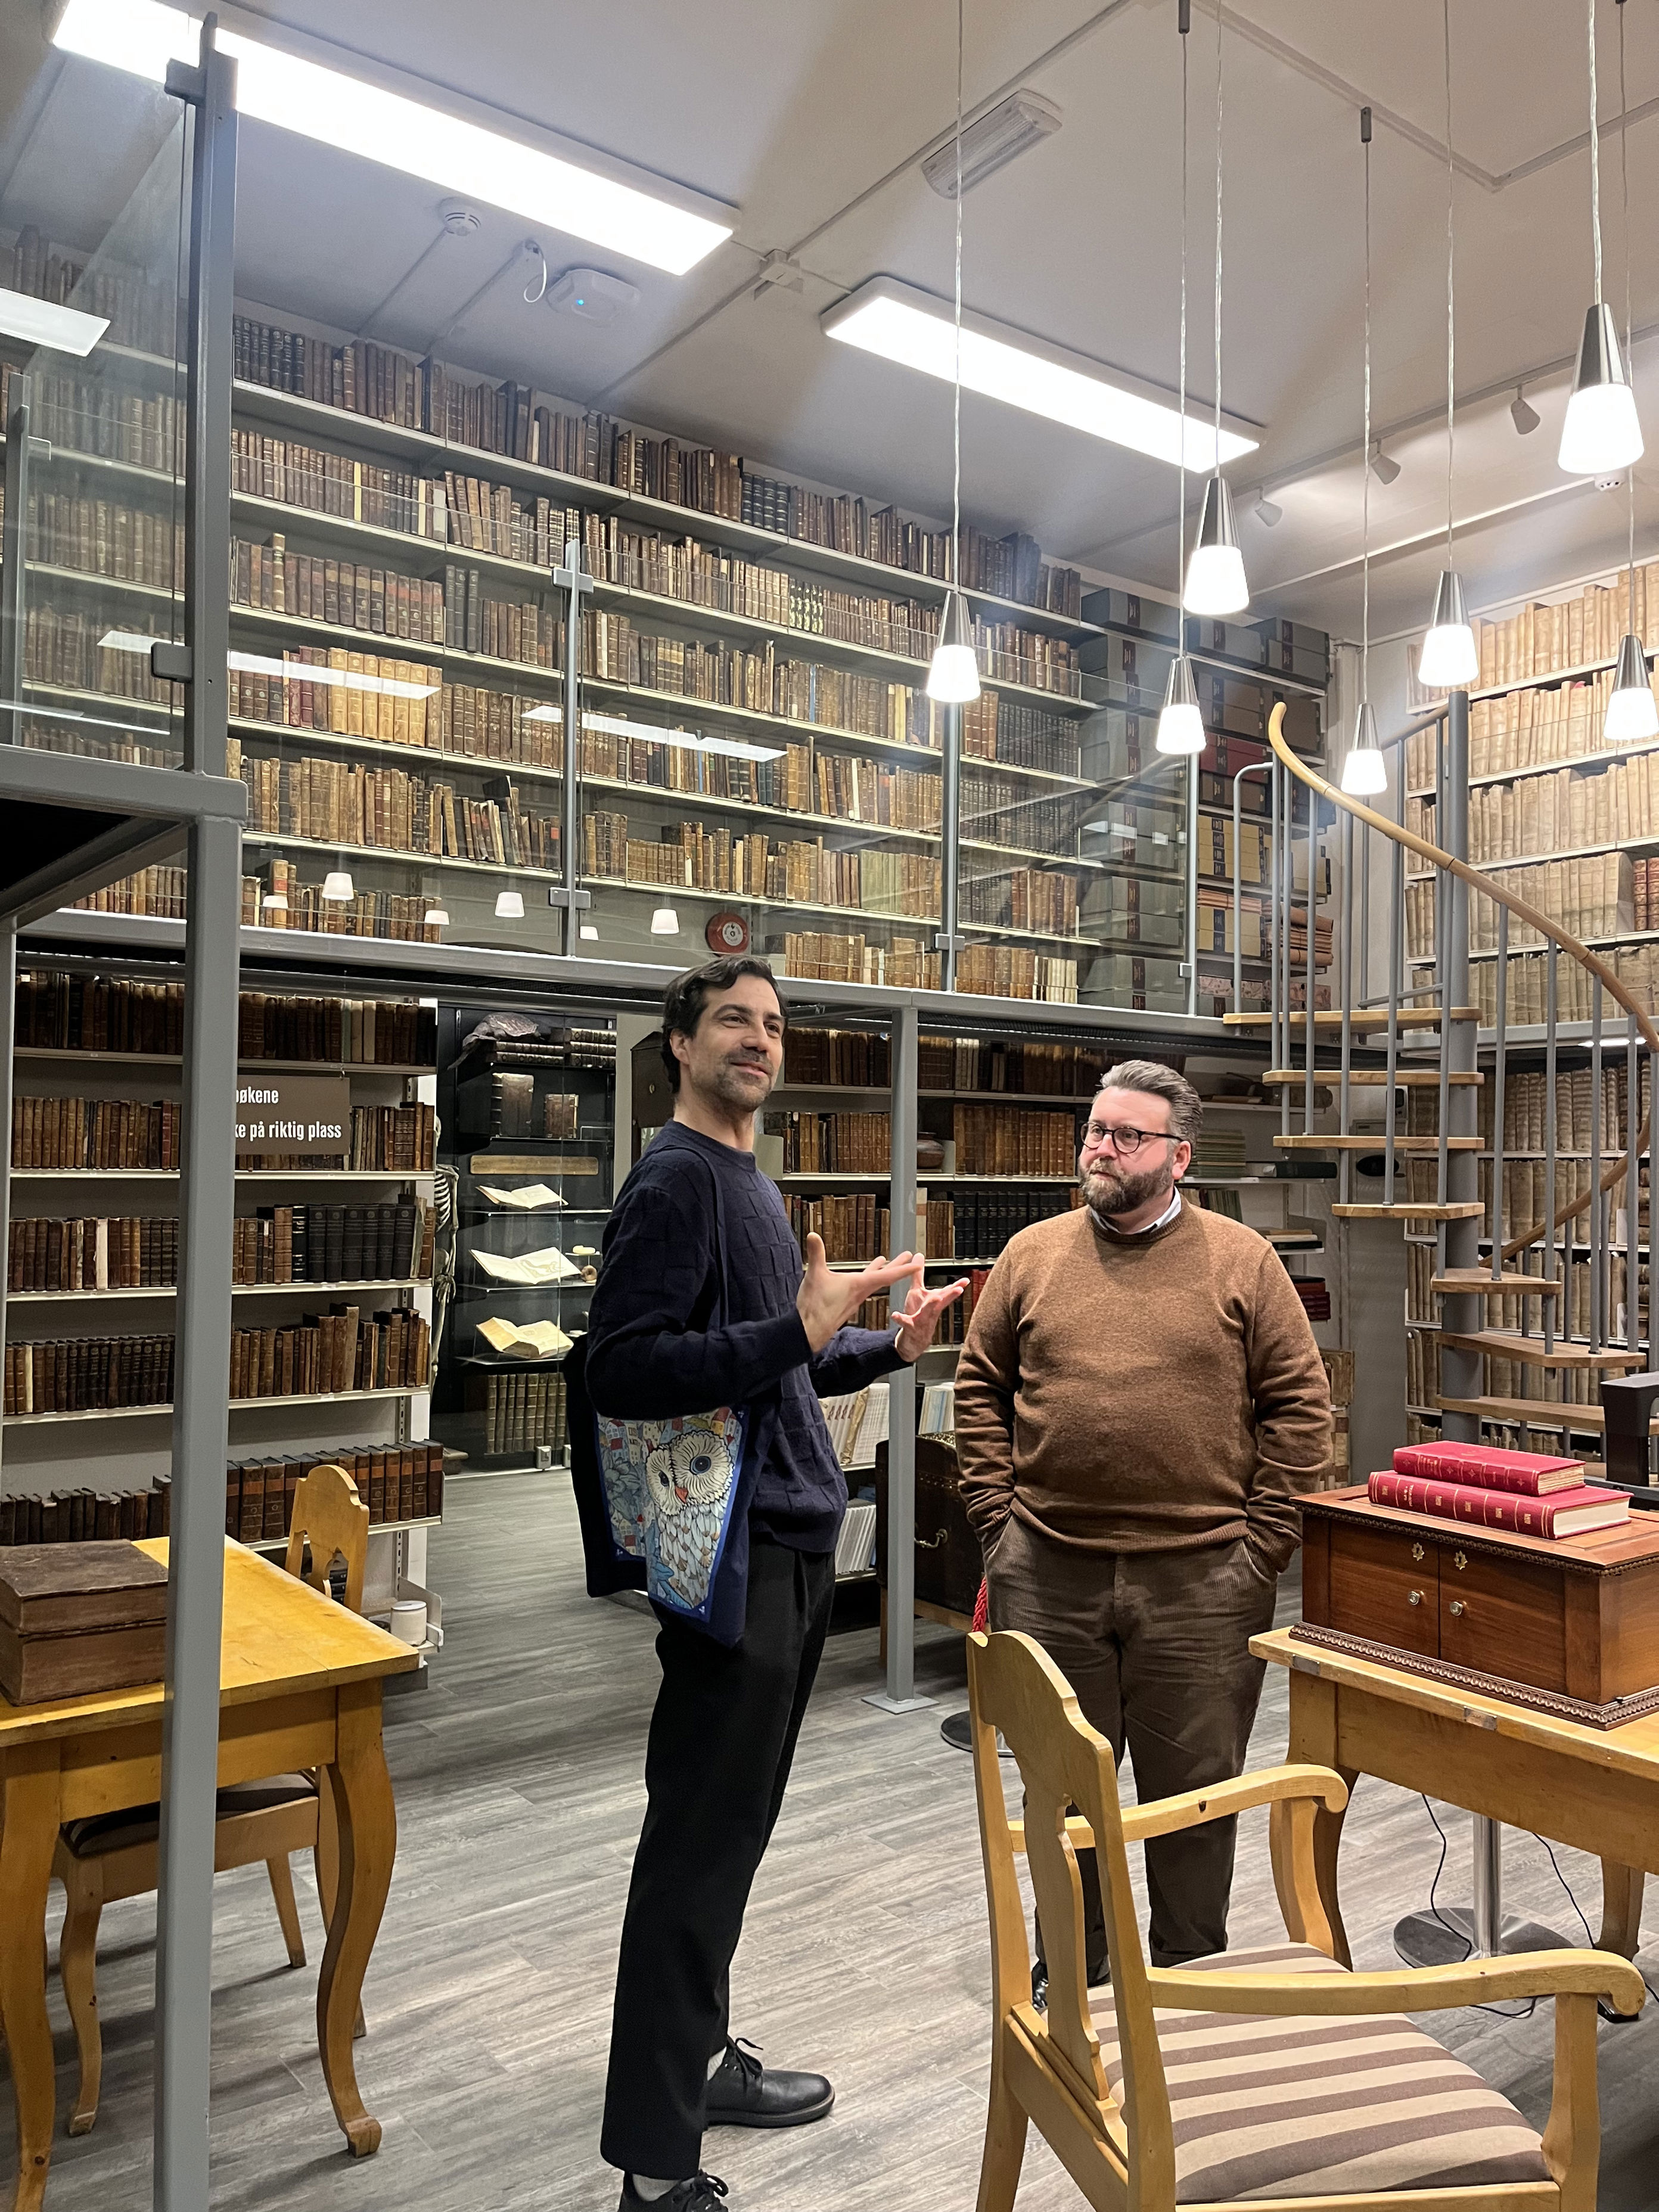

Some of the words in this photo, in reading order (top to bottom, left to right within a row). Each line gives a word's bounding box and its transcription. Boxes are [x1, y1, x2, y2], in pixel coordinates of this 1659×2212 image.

[250, 1121, 265, 1142] på
[269, 1121, 304, 1141] riktig
[308, 1121, 341, 1142] plass
